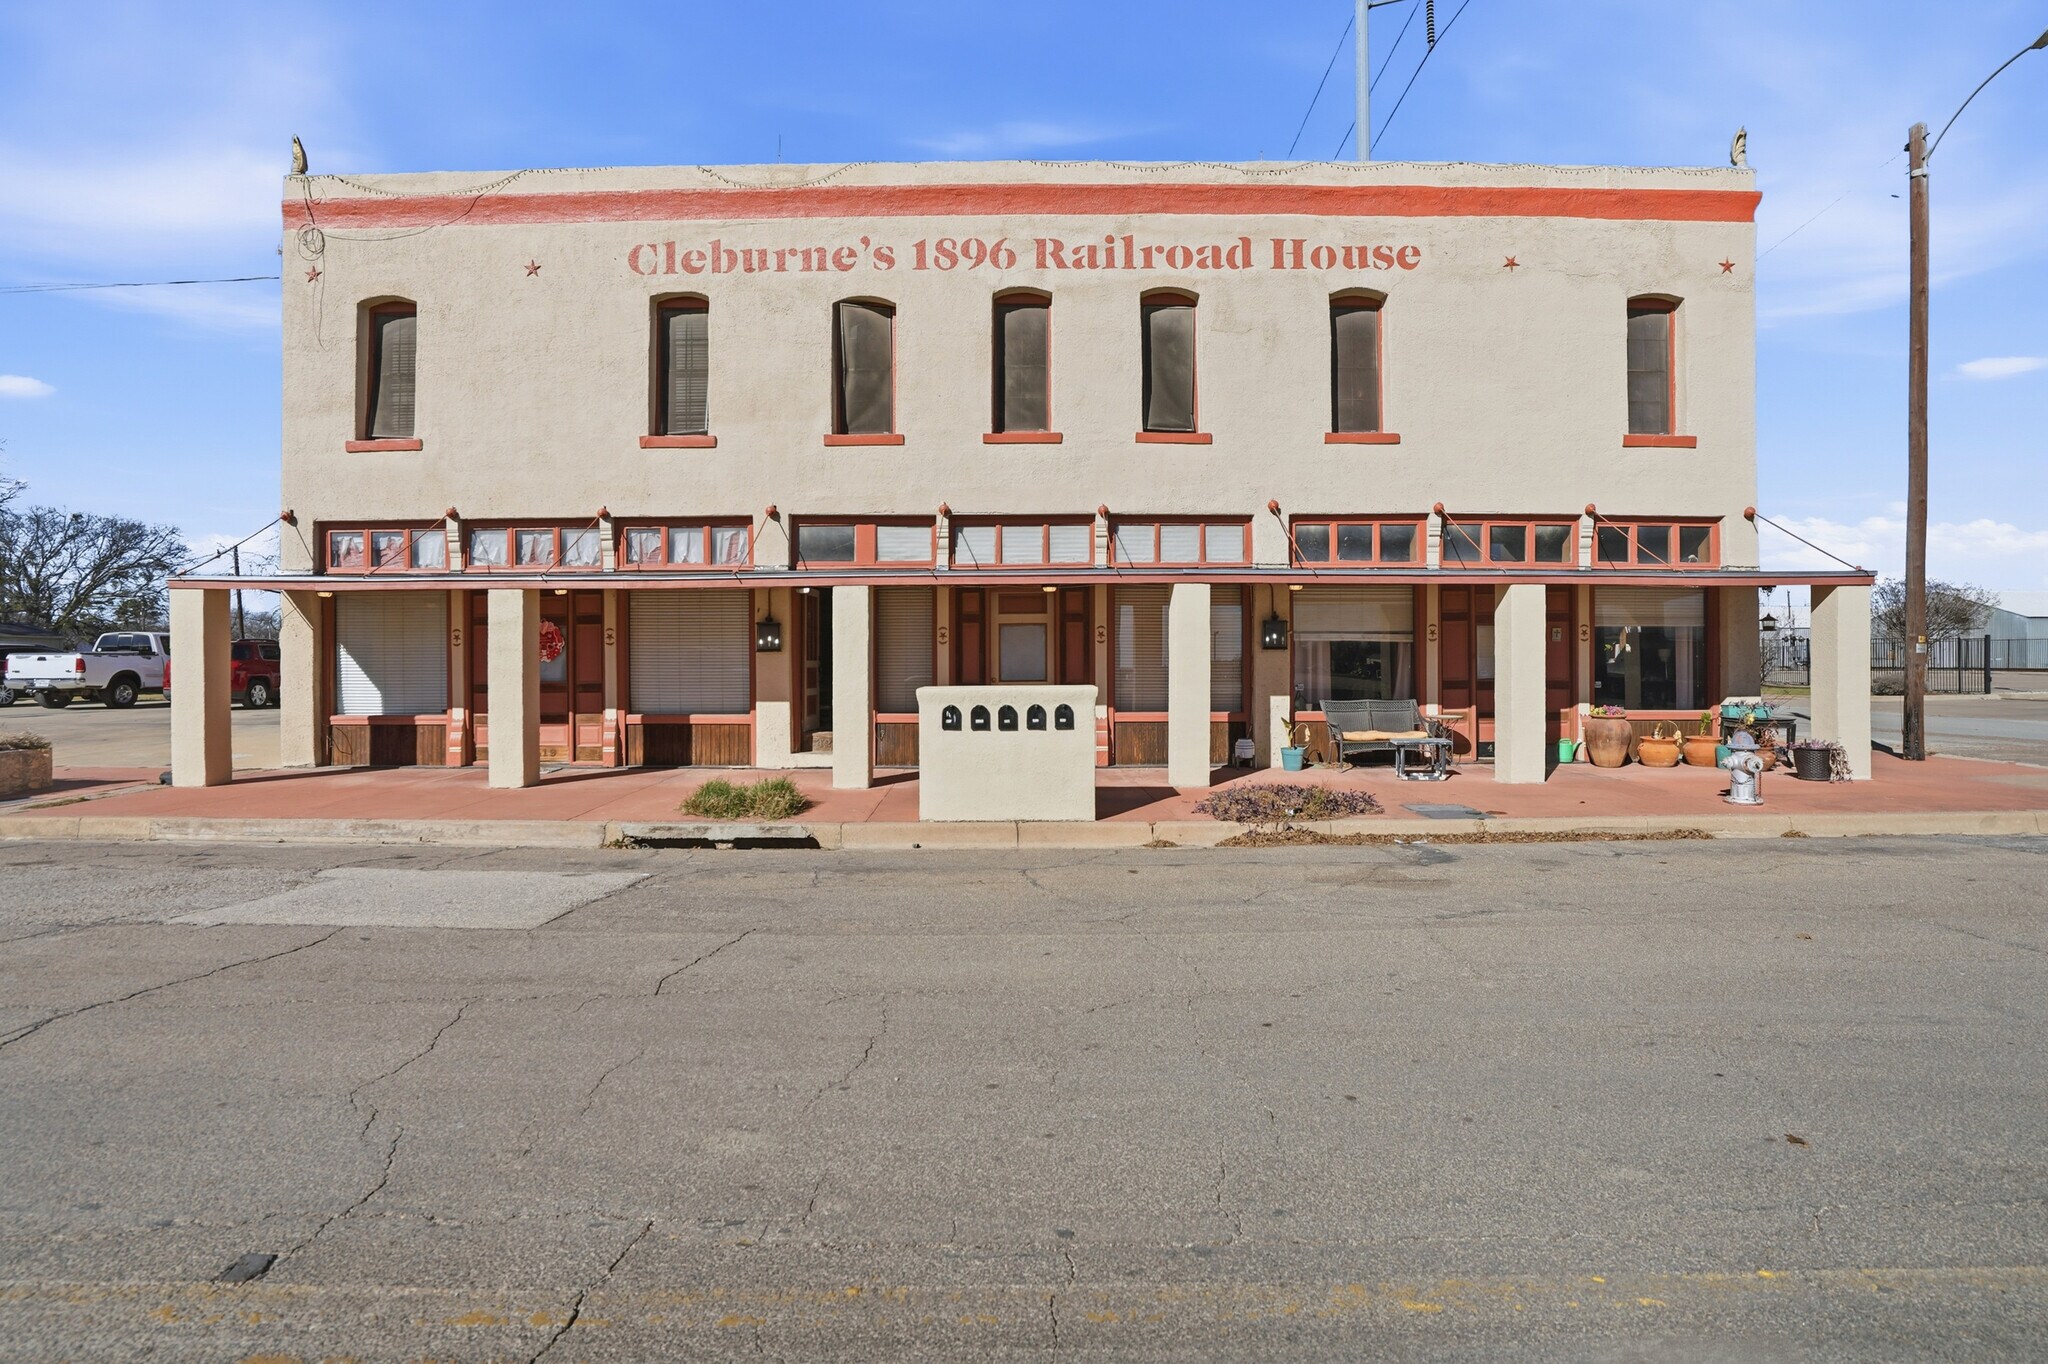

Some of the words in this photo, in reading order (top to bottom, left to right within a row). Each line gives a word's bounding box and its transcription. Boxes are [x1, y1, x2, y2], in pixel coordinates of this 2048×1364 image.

[628, 236, 895, 275] Cleburne's
[911, 237, 1016, 271] 1896
[1033, 235, 1253, 270] Railroad
[1271, 237, 1421, 270] House
